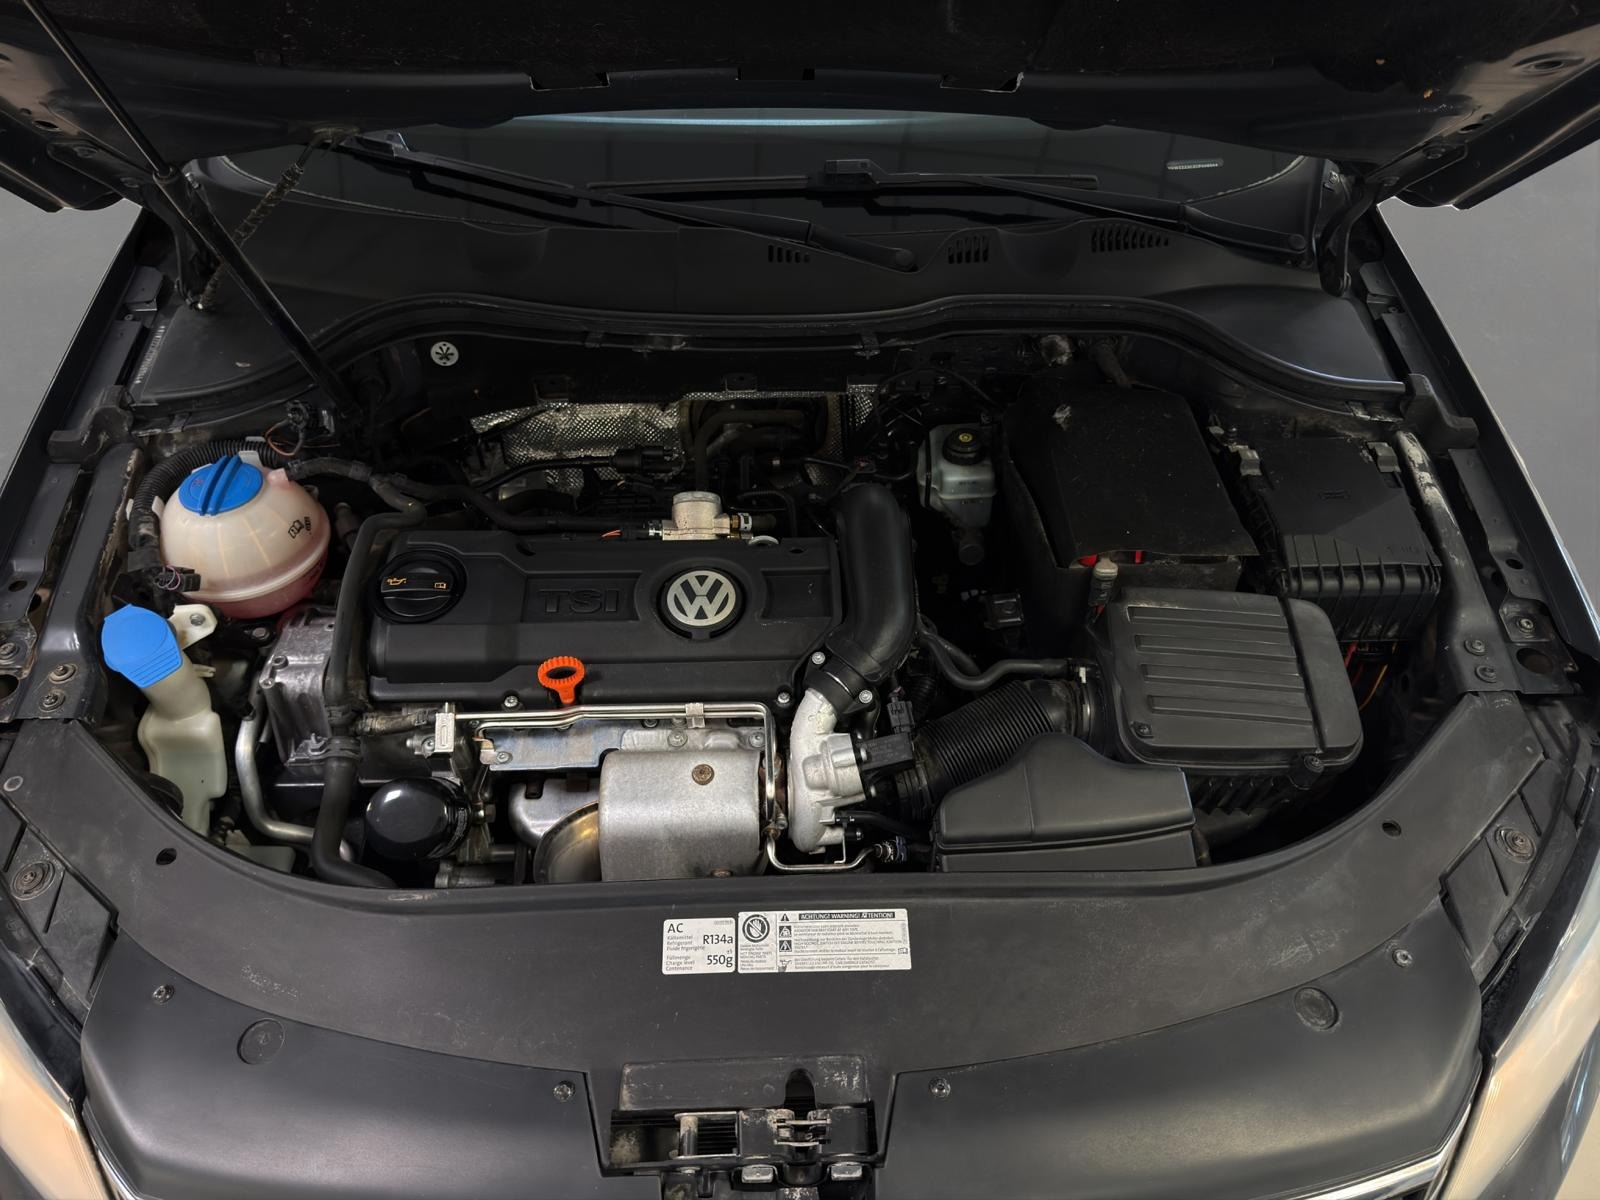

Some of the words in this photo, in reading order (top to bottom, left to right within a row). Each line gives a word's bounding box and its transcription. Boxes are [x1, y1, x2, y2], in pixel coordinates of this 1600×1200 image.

[538, 588, 620, 614] TSI
[667, 923, 684, 933] AC
[703, 934, 733, 944] R134a
[707, 954, 733, 968] 550g
